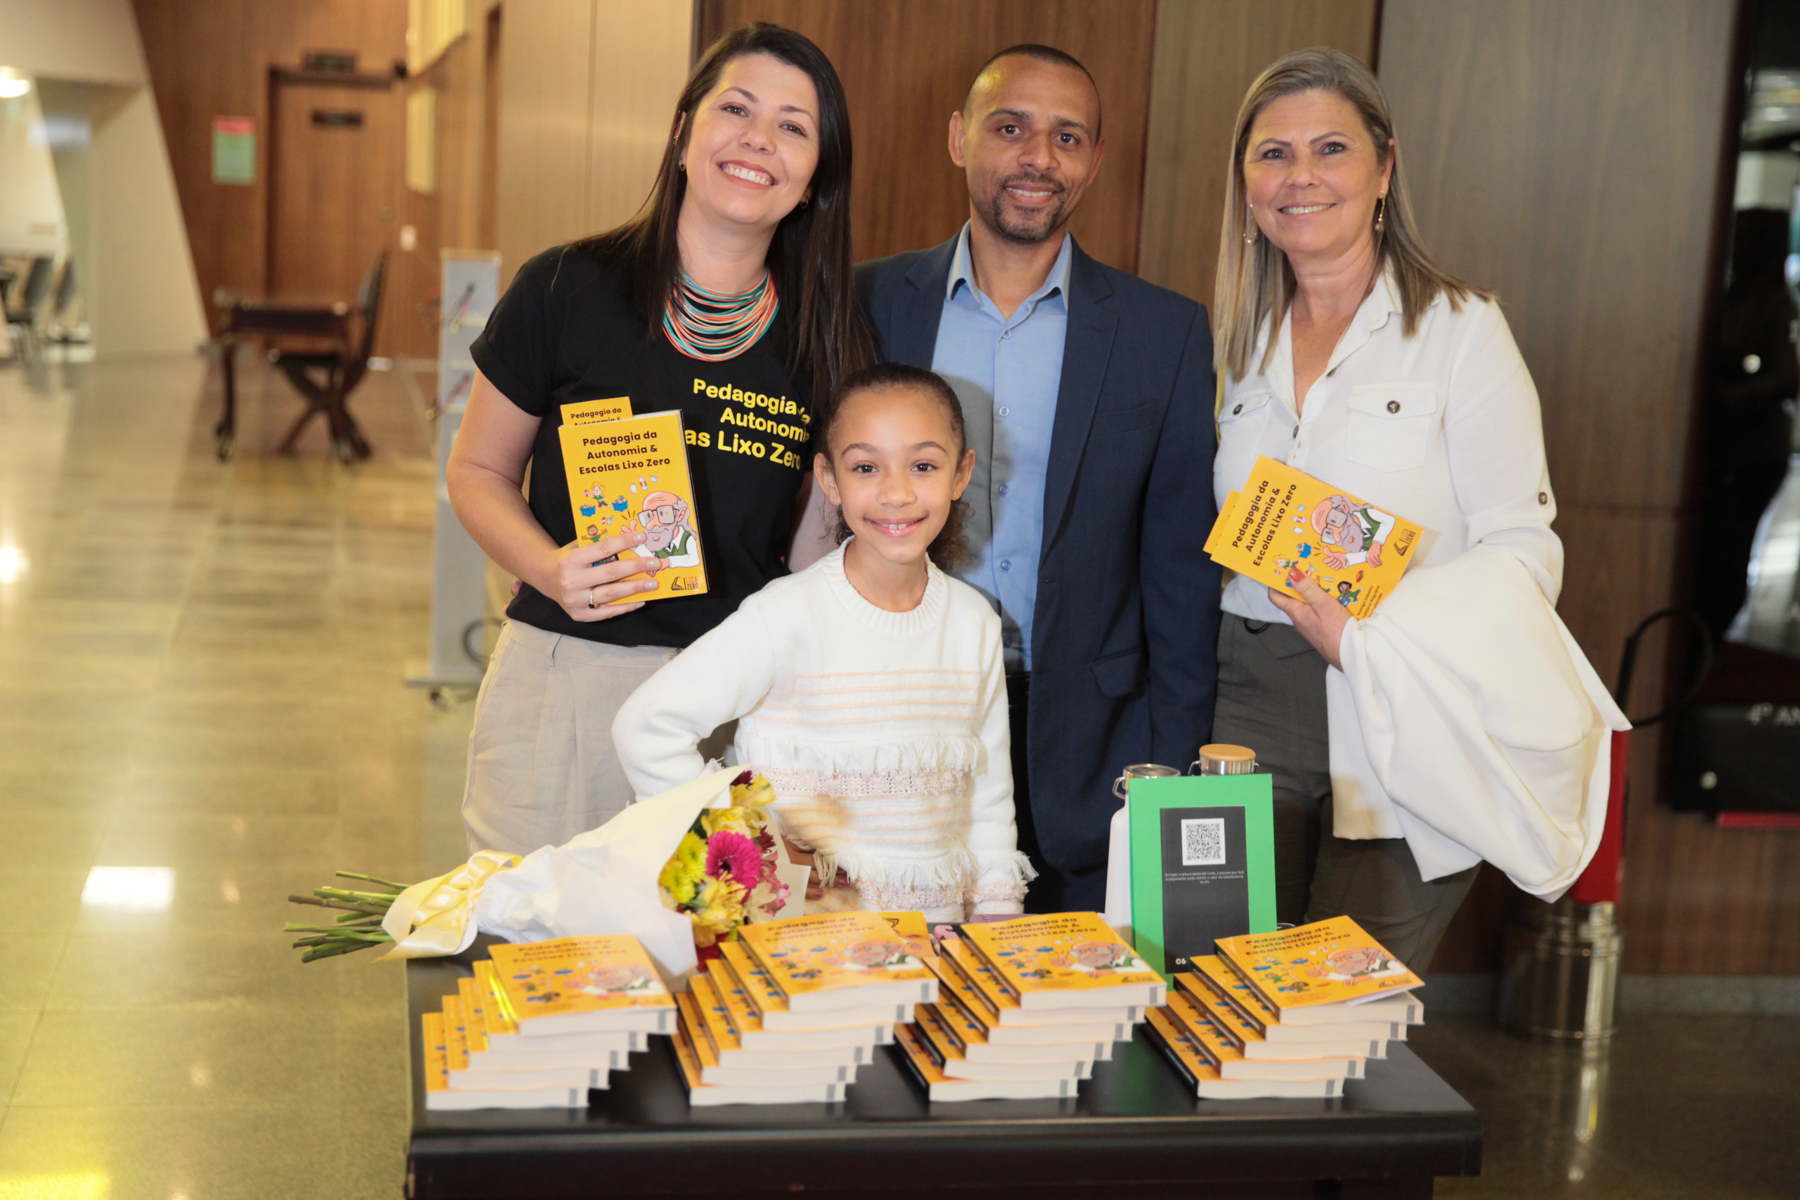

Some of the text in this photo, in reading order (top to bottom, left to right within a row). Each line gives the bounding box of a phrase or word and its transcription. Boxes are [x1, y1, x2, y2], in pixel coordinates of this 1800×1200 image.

[693, 378, 797, 415] Pedagogia
[570, 408, 610, 419] Pedagogia
[583, 431, 657, 446] Pedagogia da
[684, 429, 710, 447] as
[718, 430, 766, 458] Lixo
[587, 444, 658, 460] Autonomia &
[580, 458, 670, 474] Escolas Lixo Zero
[1232, 480, 1269, 548] Pedagogia da
[1246, 496, 1276, 552] Autonomia
[1253, 484, 1296, 566] Escolas Lixo Zero
[1246, 930, 1312, 945] Pedagogia
[1254, 934, 1322, 949] Autonomia
[1246, 945, 1292, 956] Escolas
